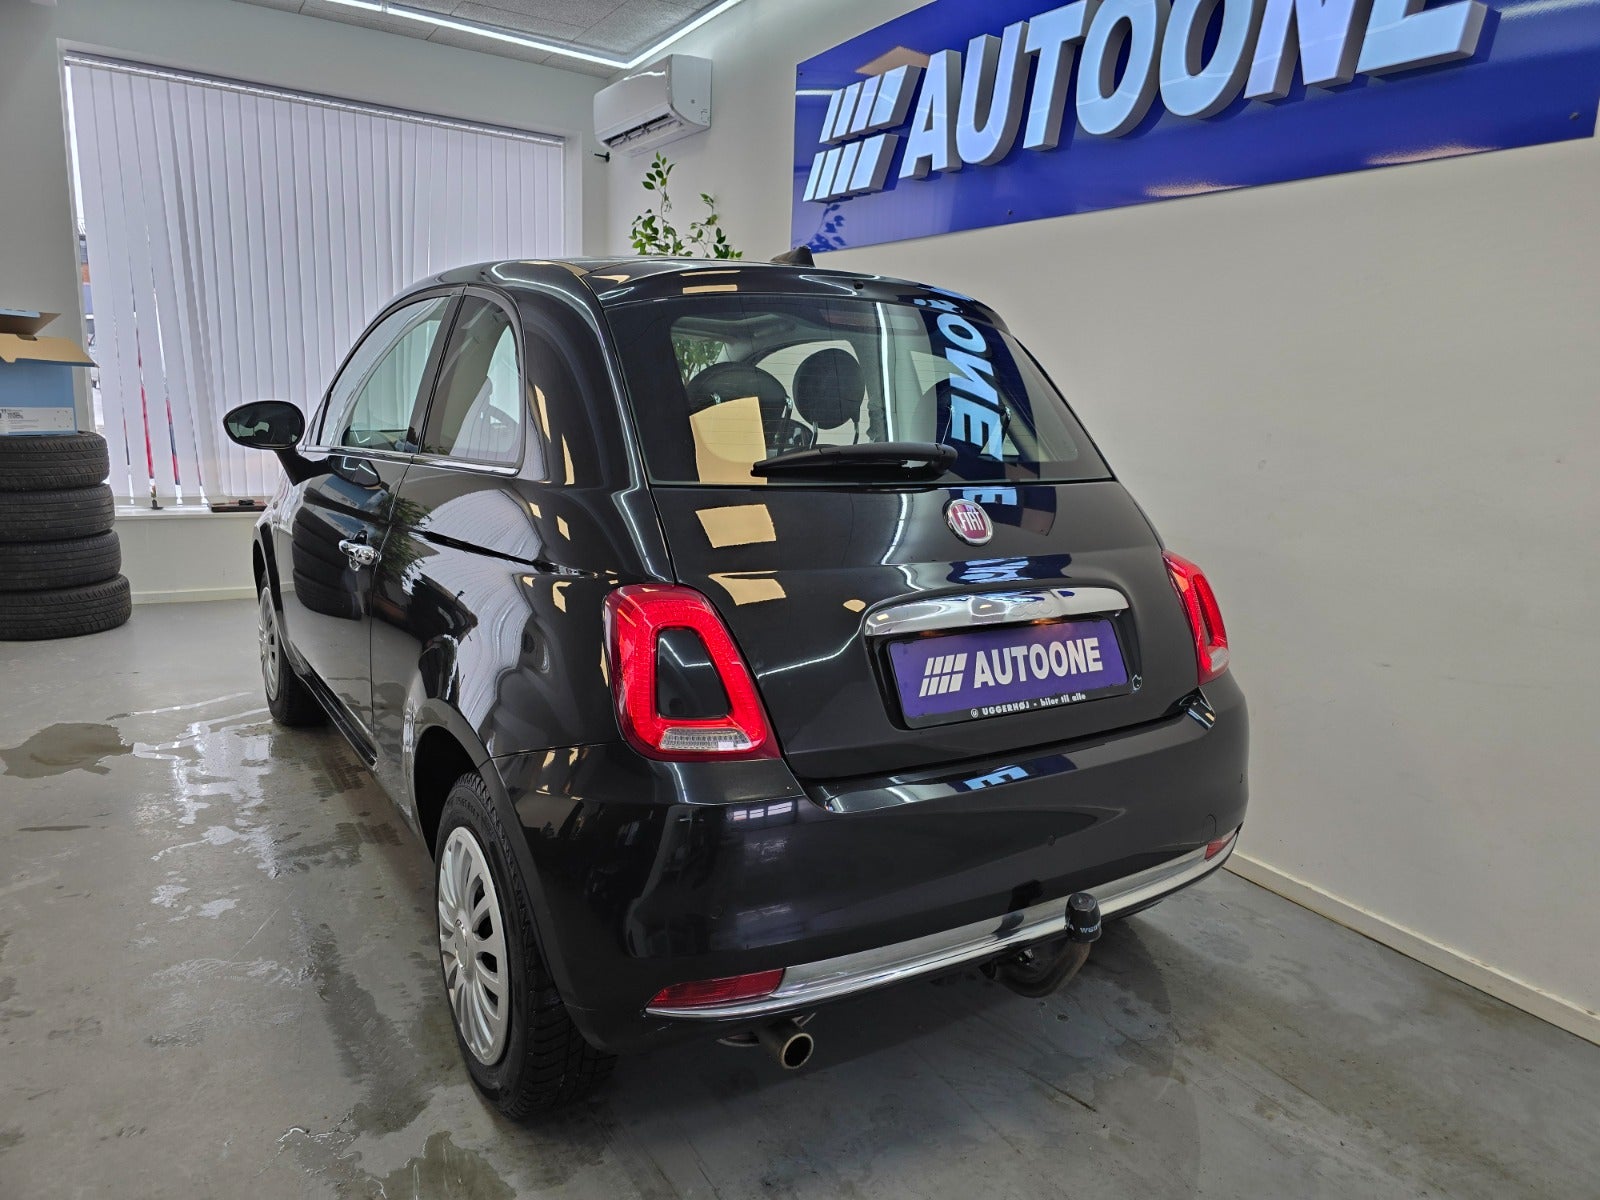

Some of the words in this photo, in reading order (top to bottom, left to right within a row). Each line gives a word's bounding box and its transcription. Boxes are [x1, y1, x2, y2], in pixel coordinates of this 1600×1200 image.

[957, 511, 985, 531] FIAT
[973, 637, 1103, 689] AUTOONE
[1040, 697, 1059, 707] biler
[1060, 694, 1070, 703] til
[1072, 693, 1087, 702] alle
